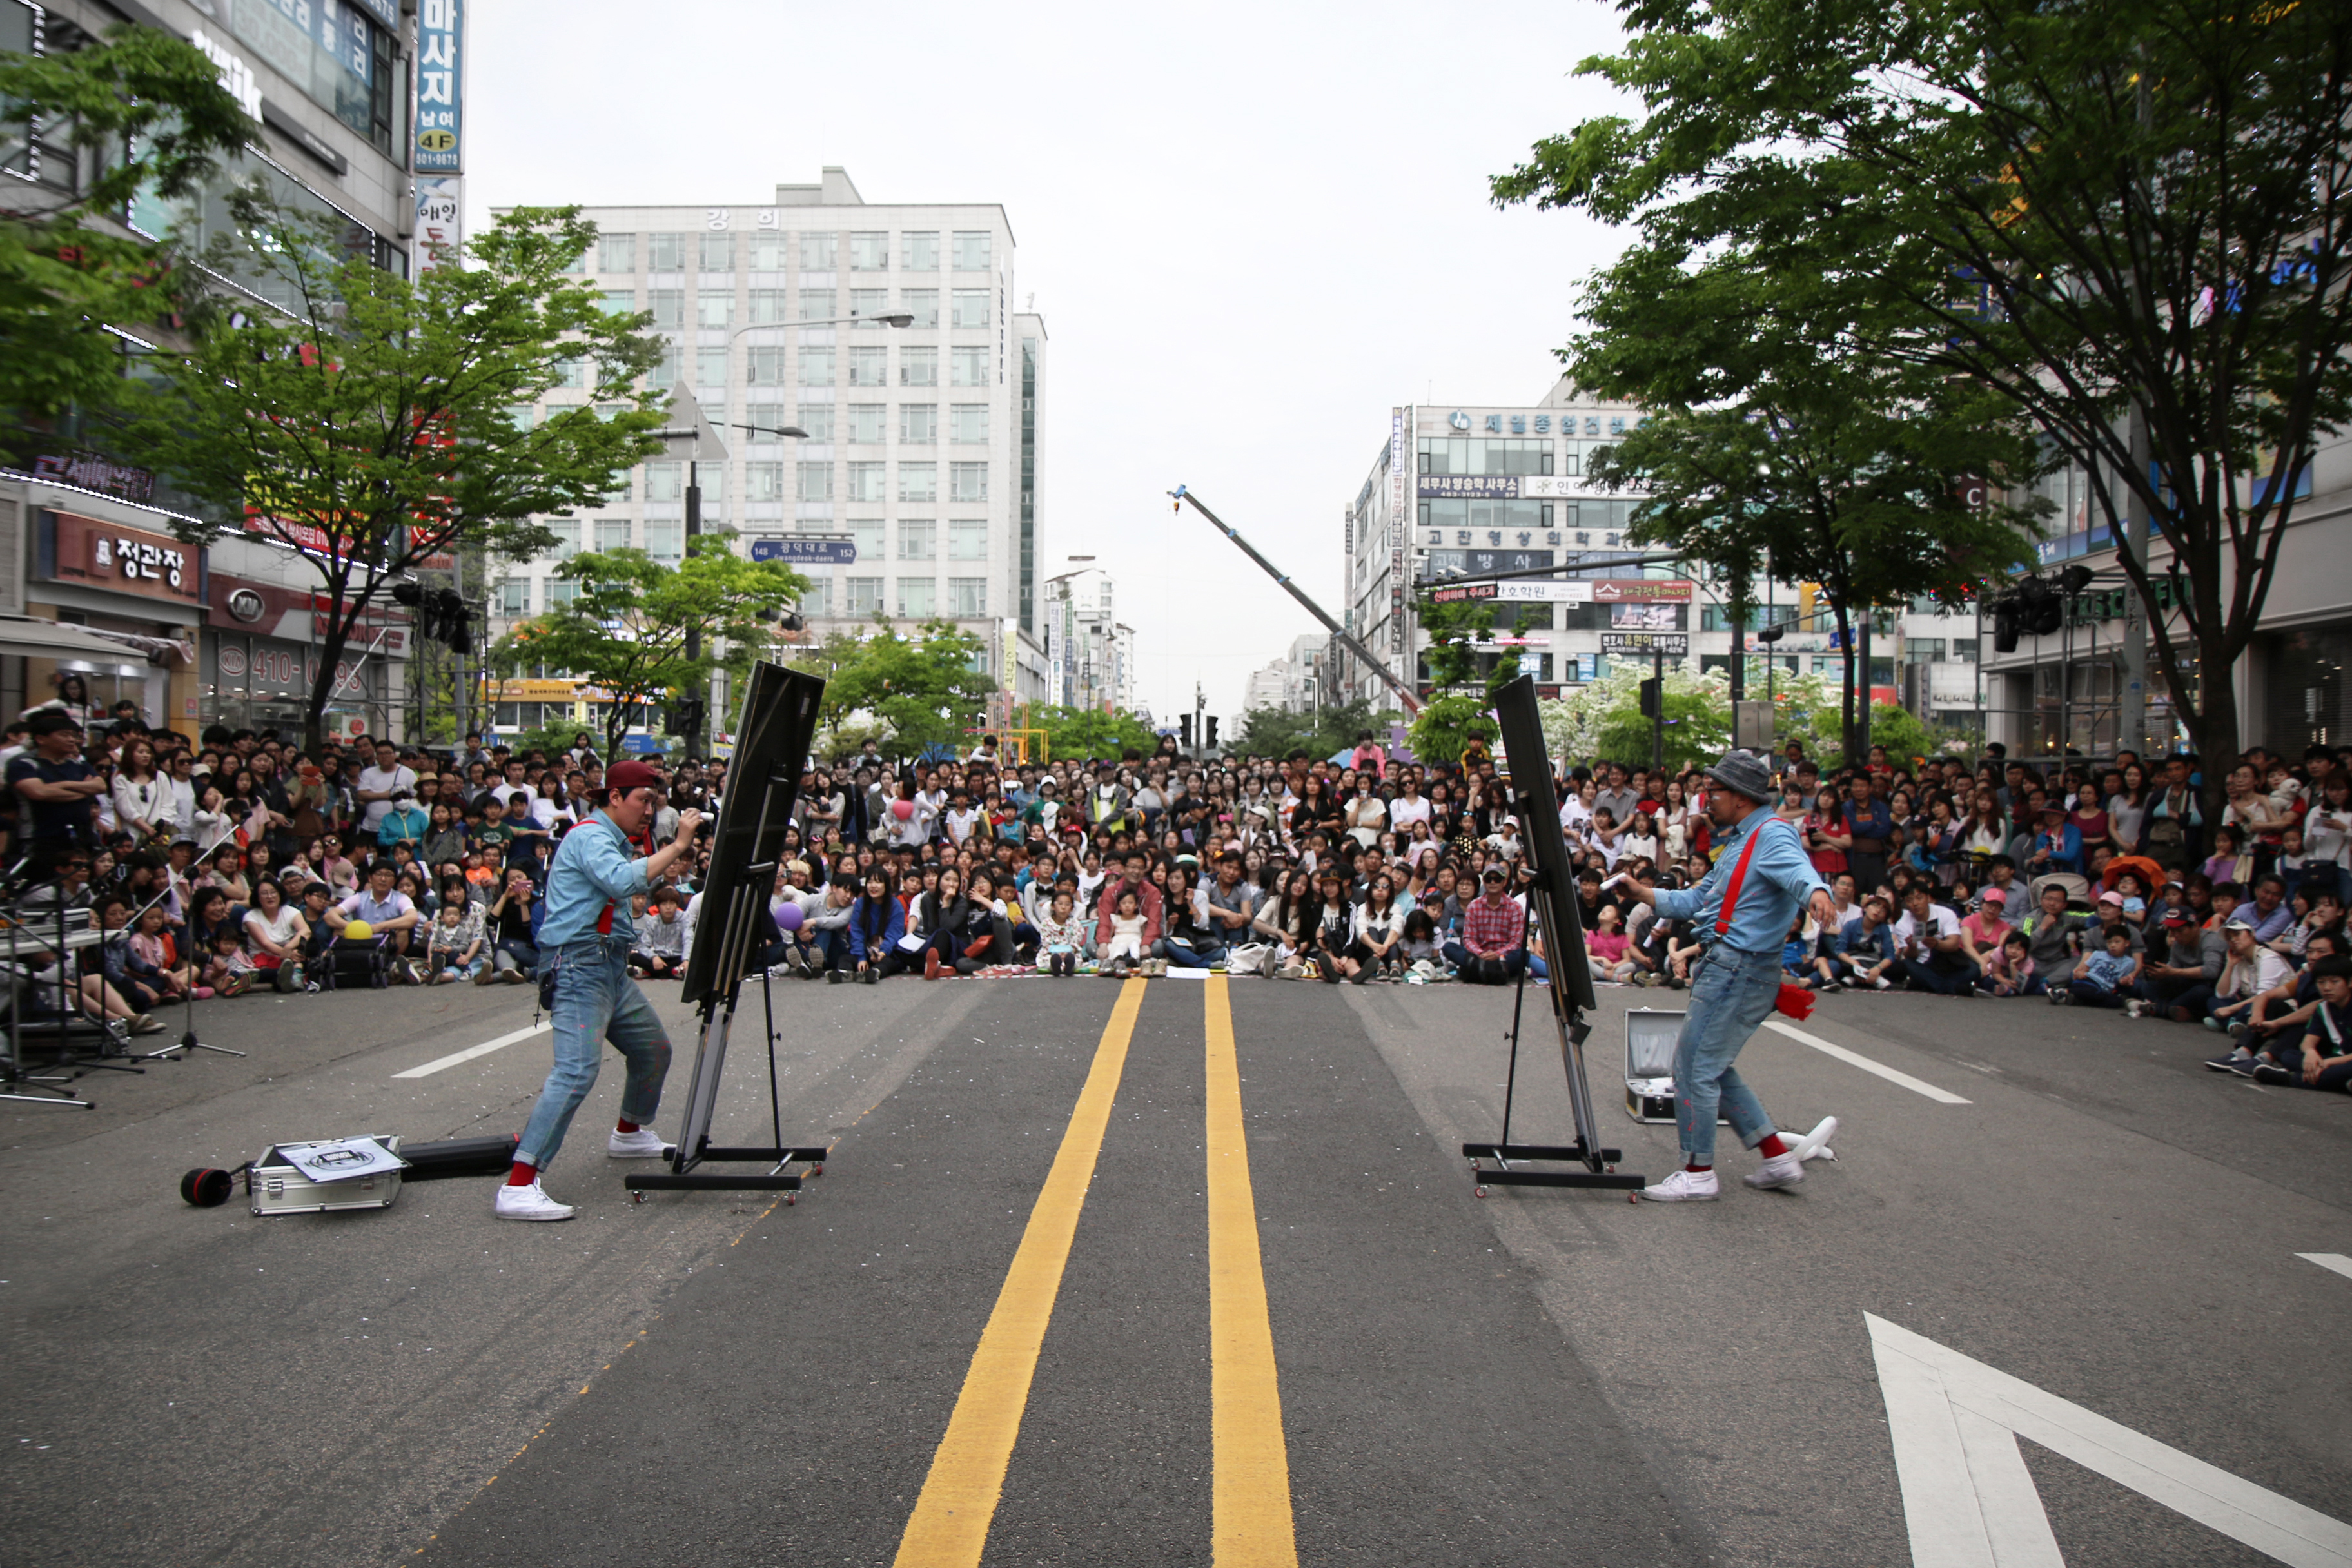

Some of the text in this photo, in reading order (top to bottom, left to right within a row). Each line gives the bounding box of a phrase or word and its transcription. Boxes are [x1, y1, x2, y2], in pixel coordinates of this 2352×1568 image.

[420, 0, 457, 106] 마사지
[420, 111, 454, 128] 남여
[420, 203, 456, 223] 매일
[1419, 476, 1451, 491] 세무사
[1485, 477, 1517, 491] 사무소
[754, 542, 854, 558] 148 광덕대로 152
[117, 538, 185, 587] 정관장
